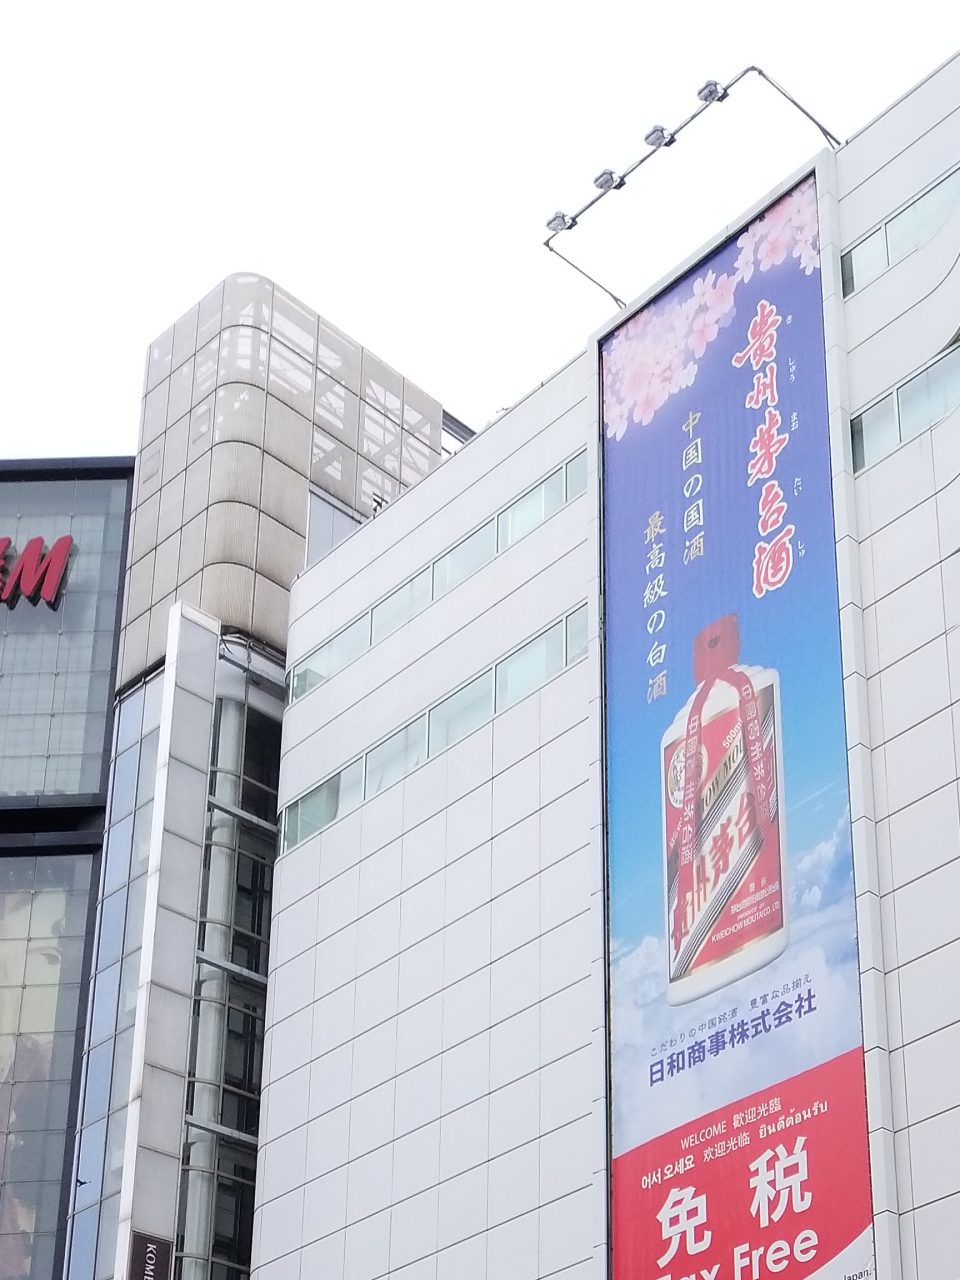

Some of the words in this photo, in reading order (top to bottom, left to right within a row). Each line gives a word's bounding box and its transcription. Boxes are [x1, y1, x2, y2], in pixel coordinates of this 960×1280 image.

[682, 411, 705, 565] 中国の国酒
[732, 300, 795, 598] 貴州茅台酒
[643, 510, 669, 704] 最高級の白酒
[649, 988, 817, 1087] 日和商事株式会社
[641, 1168, 661, 1189] 어서
[663, 1155, 695, 1180] 오세요
[703, 1131, 750, 1162] 欢迎光临
[680, 1121, 727, 1150] WELCOME
[655, 1136, 812, 1269] 免税
